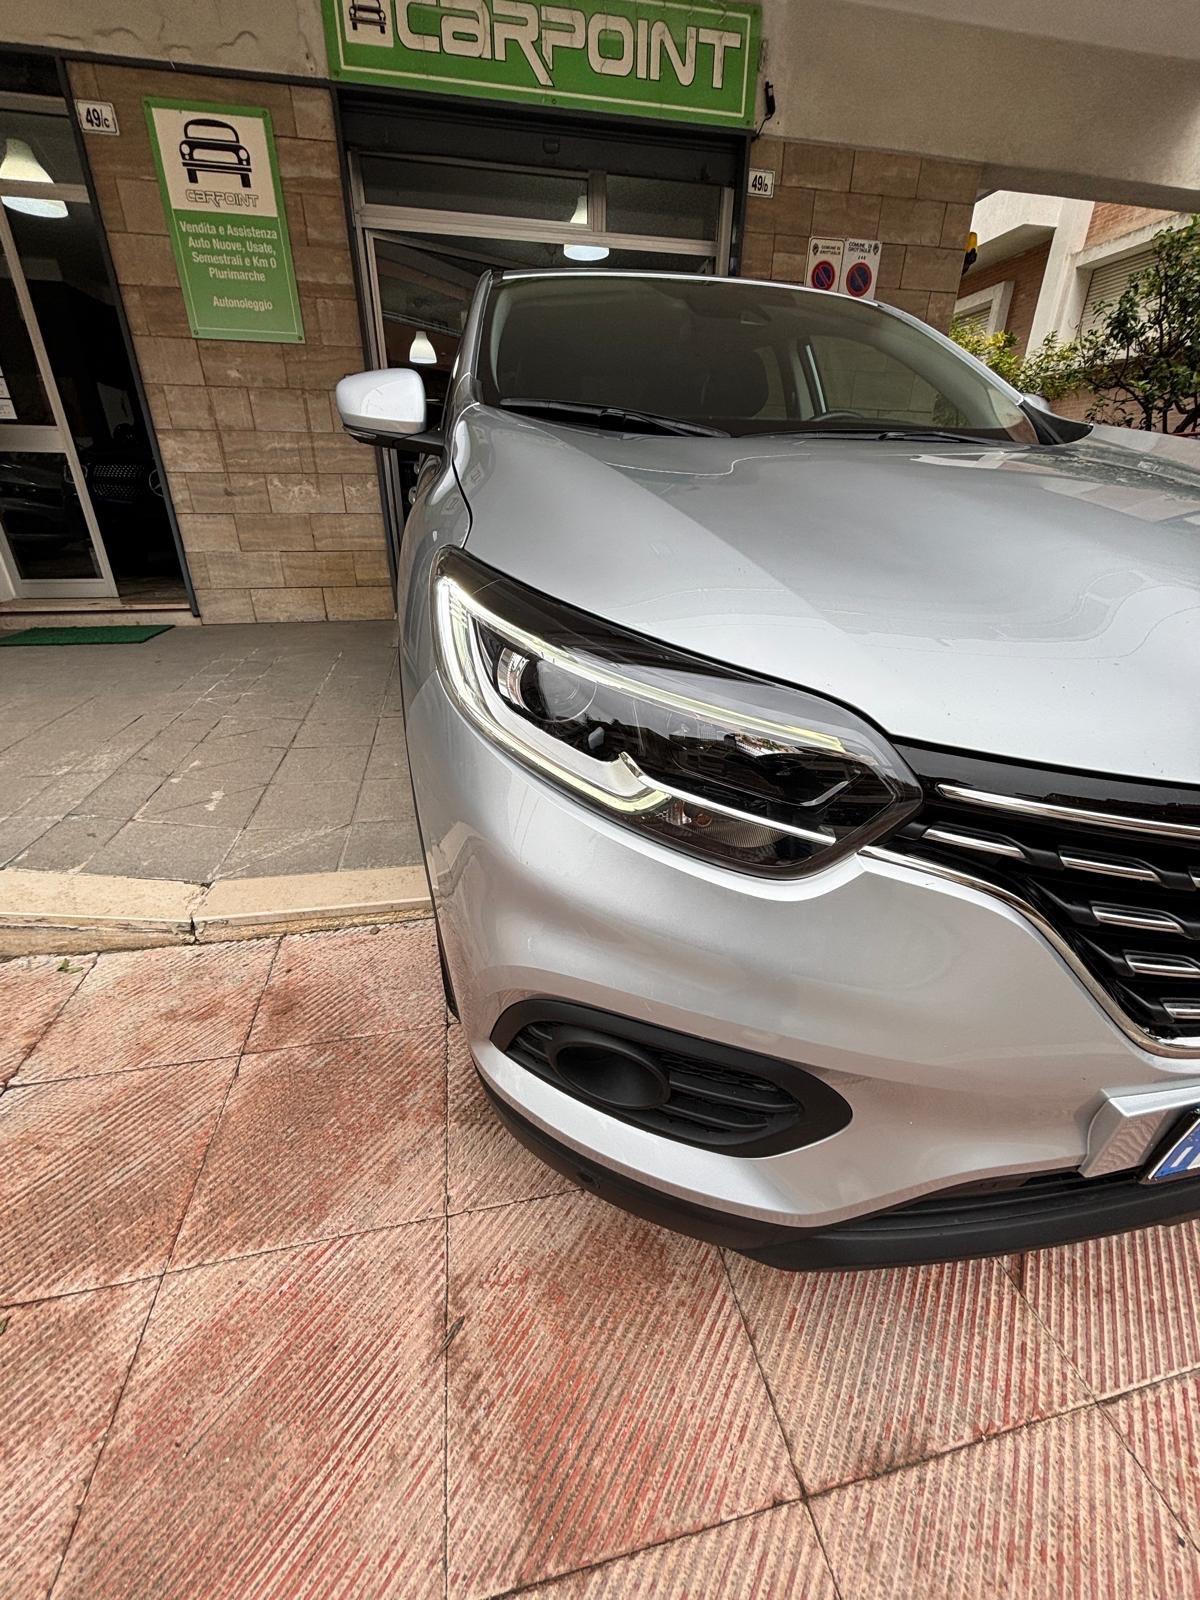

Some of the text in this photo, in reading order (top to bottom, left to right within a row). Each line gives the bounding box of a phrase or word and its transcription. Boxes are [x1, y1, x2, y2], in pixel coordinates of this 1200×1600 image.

[179, 221, 278, 239] Vendita e Assistenza
[188, 236, 276, 256] Auto Nuove, Usate,
[191, 251, 243, 266] Semestrali
[245, 257, 251, 266] e
[252, 255, 269, 268] Km
[208, 267, 267, 282] Plurimarche
[212, 295, 273, 312] Autonoleggio
